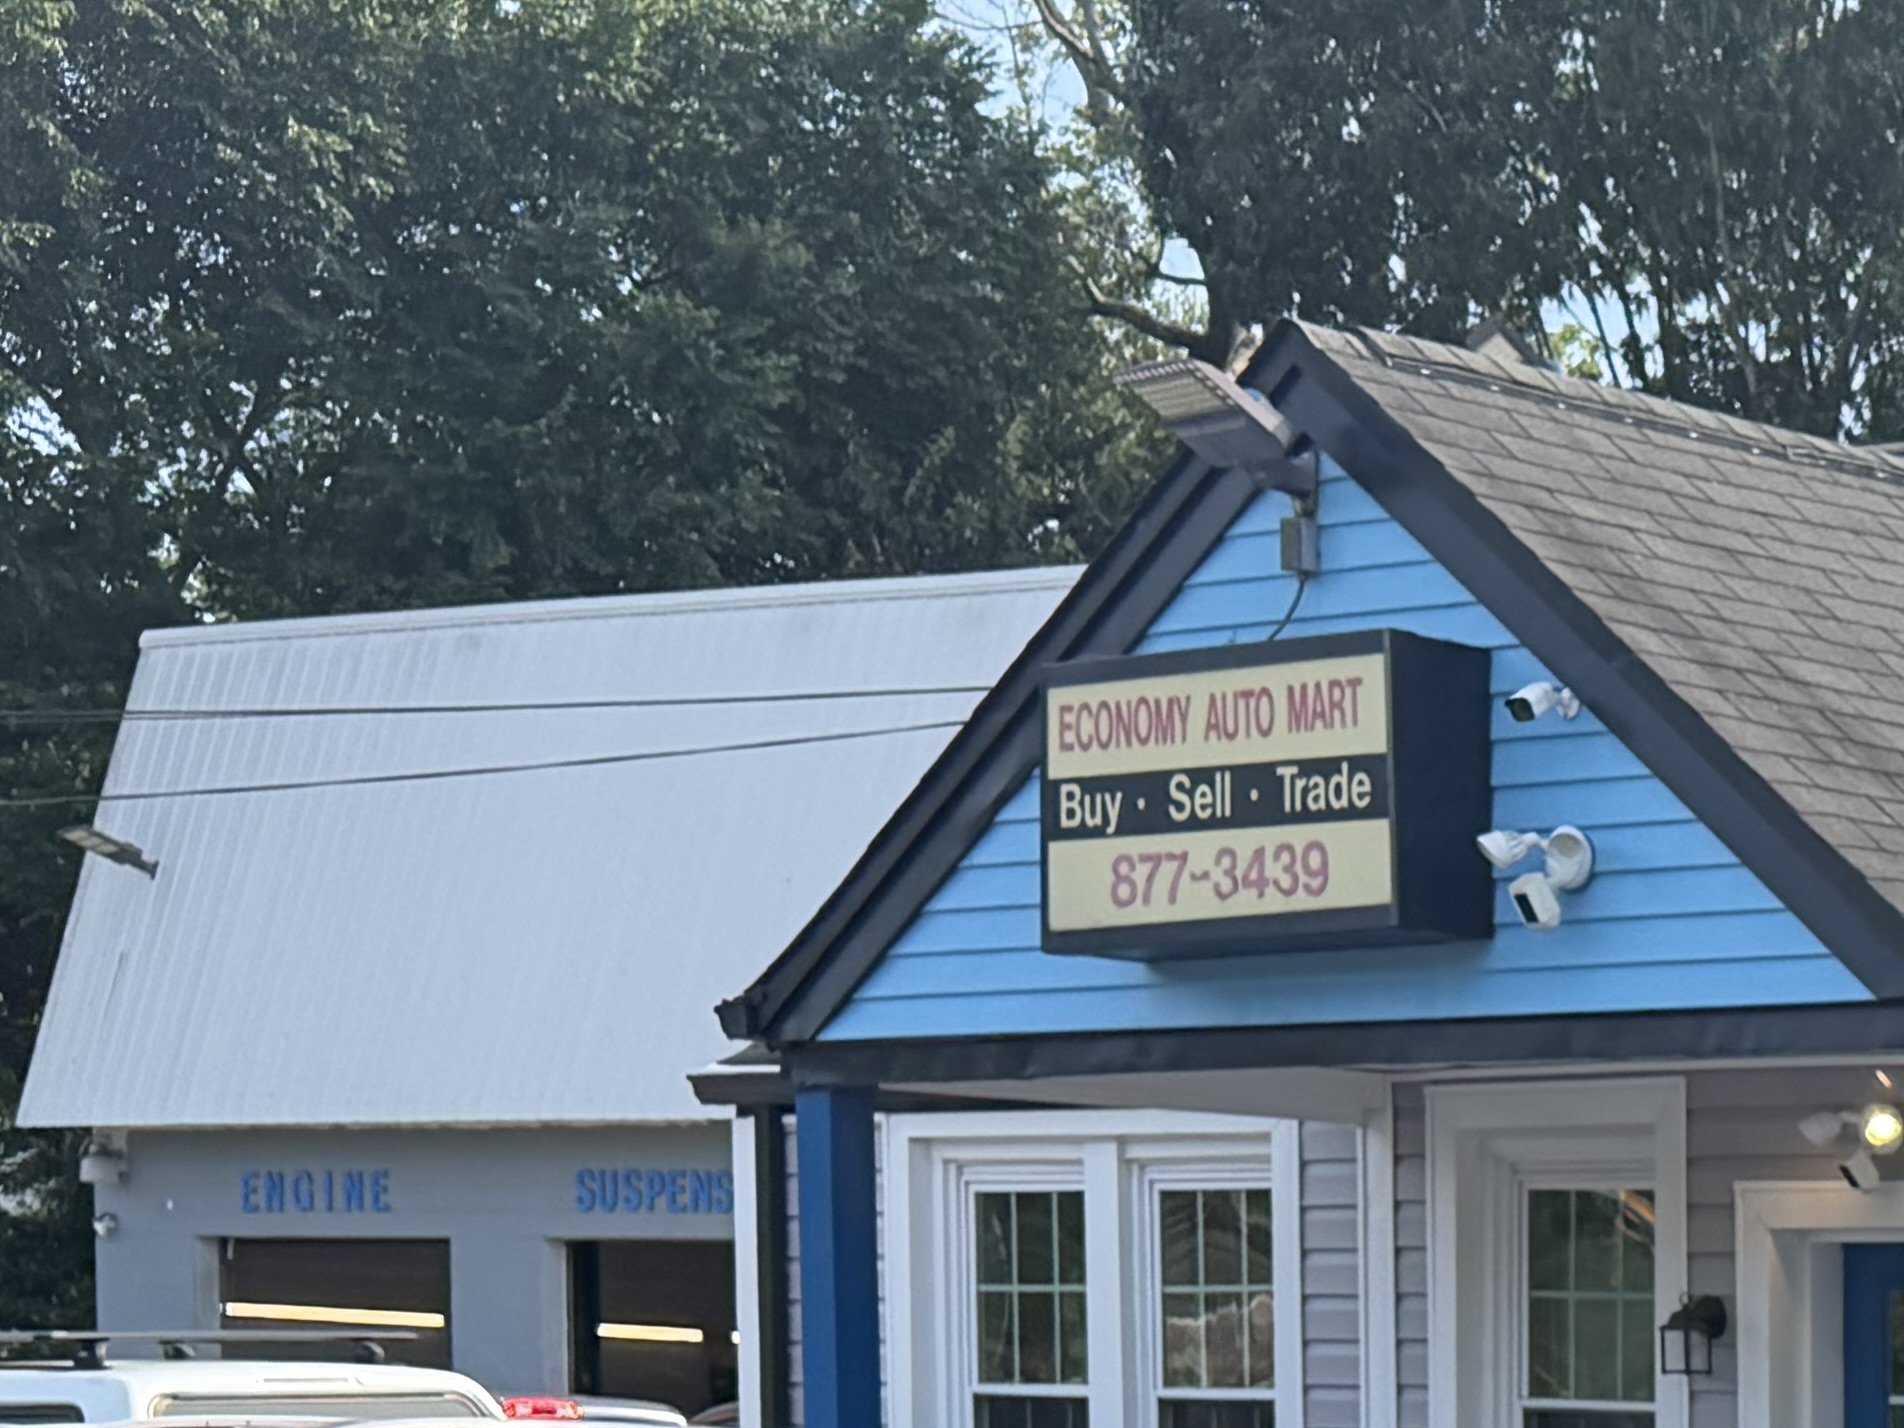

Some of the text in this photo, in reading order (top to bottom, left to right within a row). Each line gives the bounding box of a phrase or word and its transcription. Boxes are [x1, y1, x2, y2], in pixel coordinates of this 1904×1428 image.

[1058, 677, 1364, 753] ECONOMY AUTO MART
[1059, 761, 1372, 835] Buy Sell Trade
[1109, 840, 1330, 909] 877-3439
[239, 1169, 392, 1215] ENGINE
